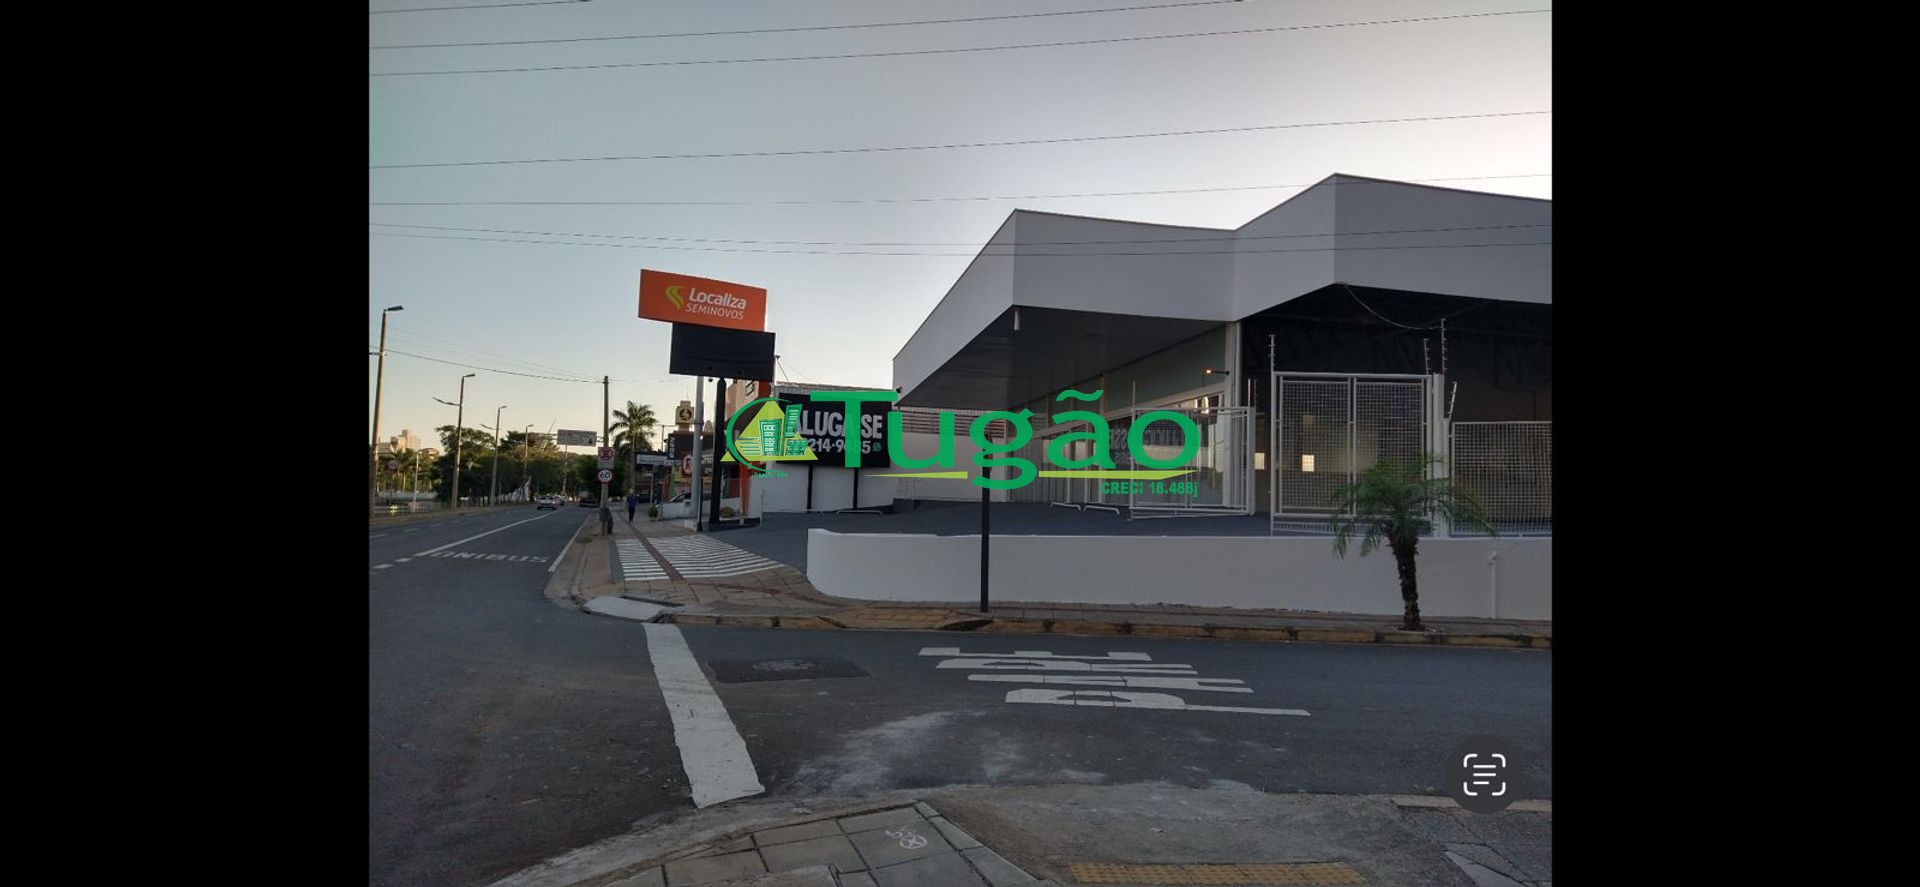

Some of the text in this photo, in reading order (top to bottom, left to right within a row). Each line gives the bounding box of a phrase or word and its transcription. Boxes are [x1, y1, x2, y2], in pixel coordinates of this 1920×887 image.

[689, 287, 747, 309] Localiza
[686, 303, 745, 321] SEMINOVOS
[600, 471, 611, 479] 60
